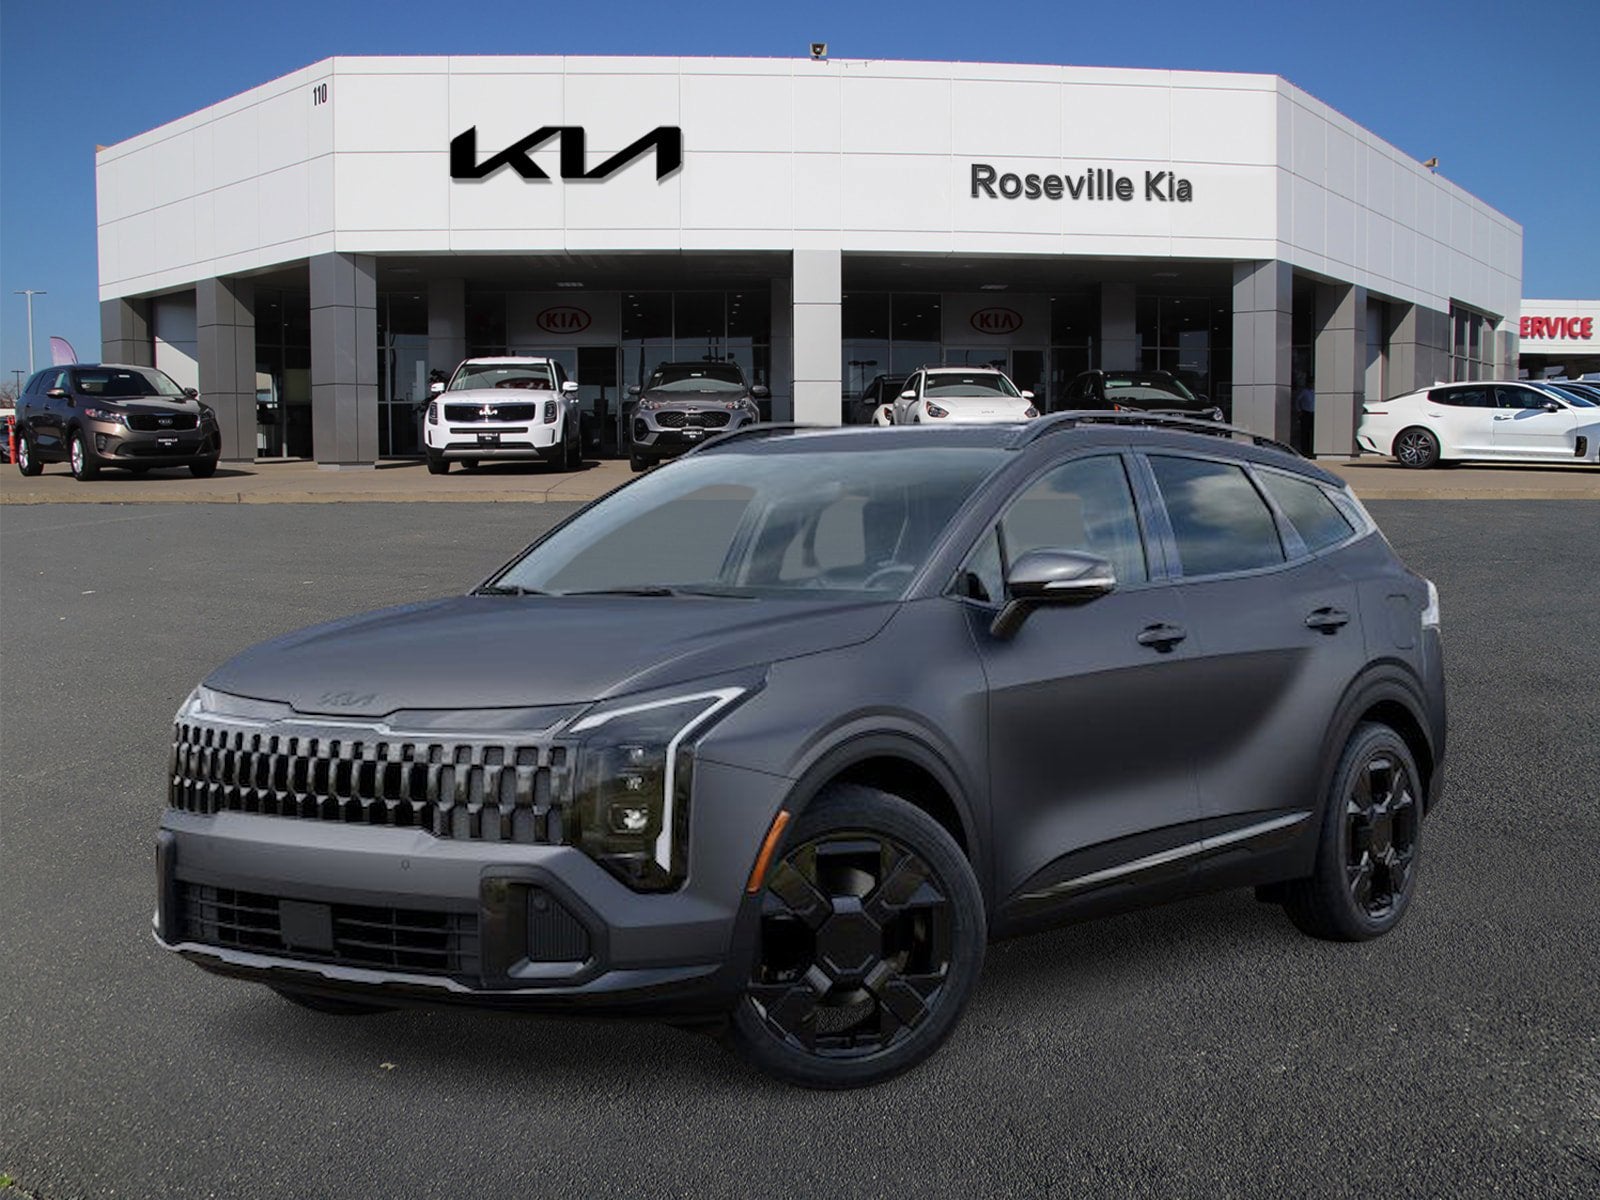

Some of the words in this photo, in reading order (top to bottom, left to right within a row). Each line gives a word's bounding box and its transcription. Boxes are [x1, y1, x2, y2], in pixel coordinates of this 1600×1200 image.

[313, 83, 328, 106] 110
[450, 125, 683, 183] KIA
[971, 163, 1135, 201] Roseville
[1144, 170, 1194, 203] Kia
[545, 312, 583, 328] KIA
[979, 312, 1015, 329] KIA
[1519, 316, 1593, 339] ERVICE
